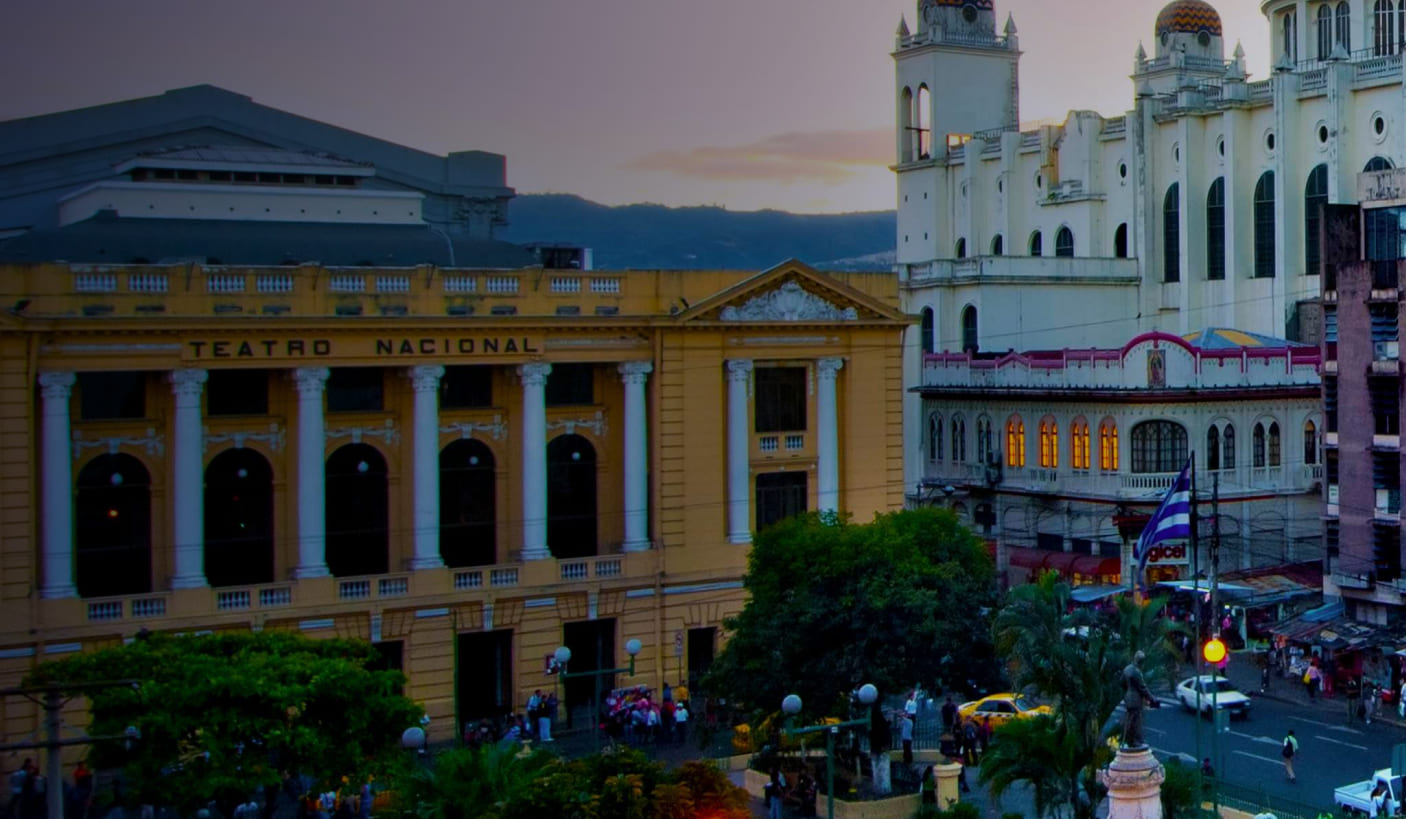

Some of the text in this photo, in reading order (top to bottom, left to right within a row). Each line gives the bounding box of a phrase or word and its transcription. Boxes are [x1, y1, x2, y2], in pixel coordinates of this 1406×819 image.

[188, 338, 538, 358] TEATRO NACIONAL
[1133, 542, 1186, 563] gicel
